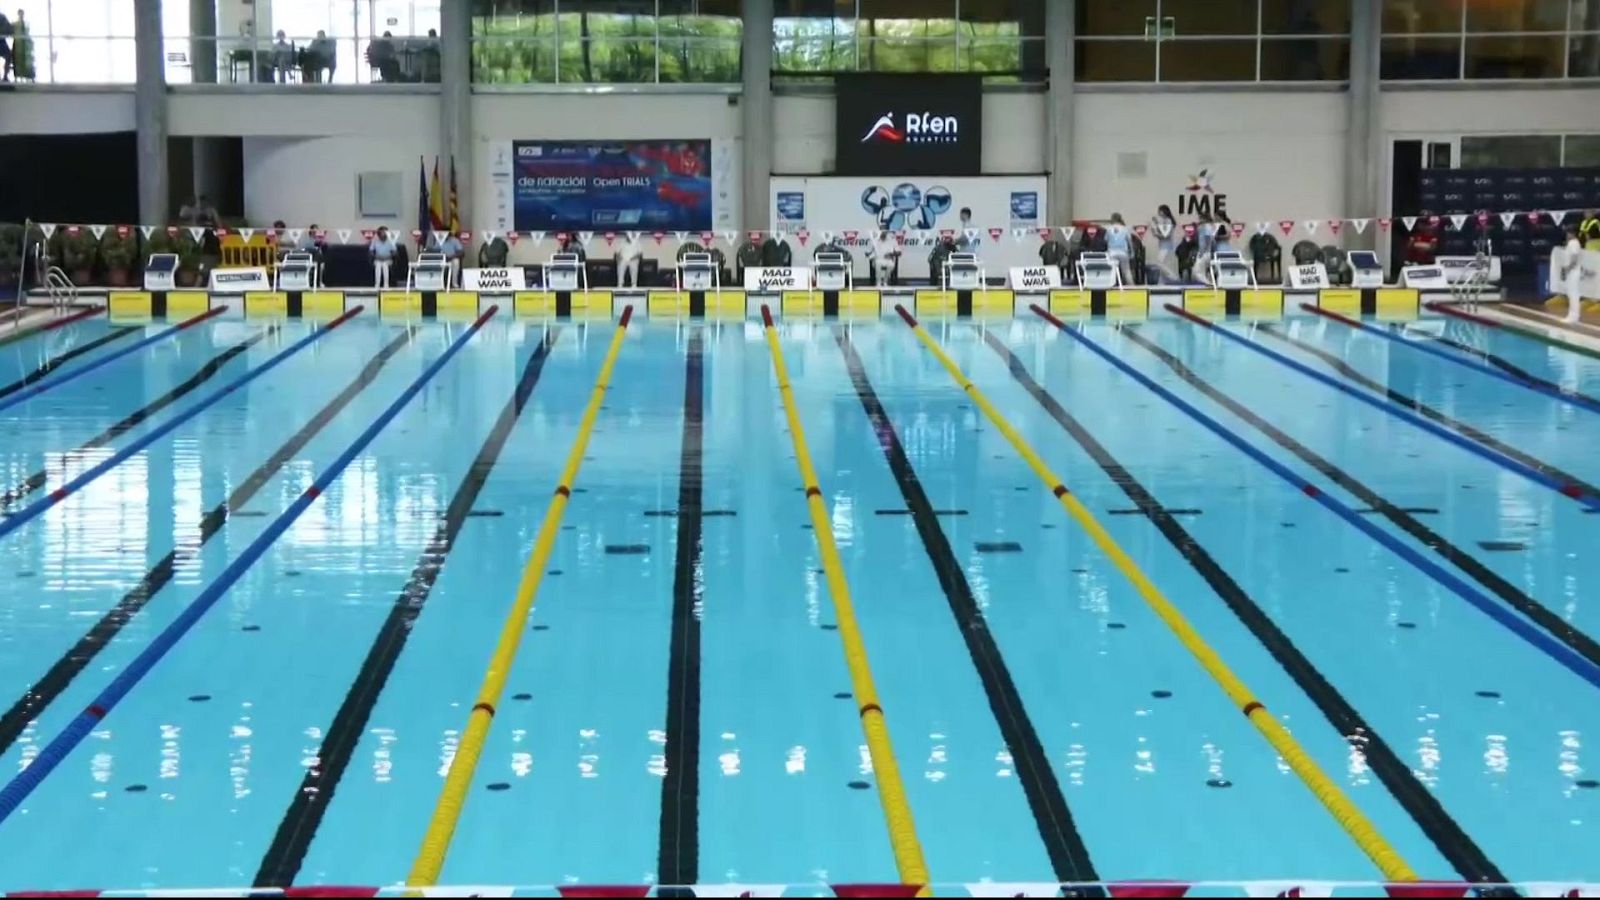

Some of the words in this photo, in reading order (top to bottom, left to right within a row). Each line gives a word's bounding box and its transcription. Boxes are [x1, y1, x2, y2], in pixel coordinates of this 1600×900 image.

[906, 111, 958, 133] Rfen
[518, 176, 536, 187] de
[593, 177, 620, 189] Open
[622, 177, 651, 187] TRIALS
[1178, 194, 1226, 215] IME
[480, 270, 508, 278] MAD
[762, 269, 792, 277] MAD
[1023, 268, 1046, 277] MAD
[478, 279, 512, 288] WAVE
[759, 278, 795, 286] WAVE
[1022, 277, 1051, 287] WAVE
